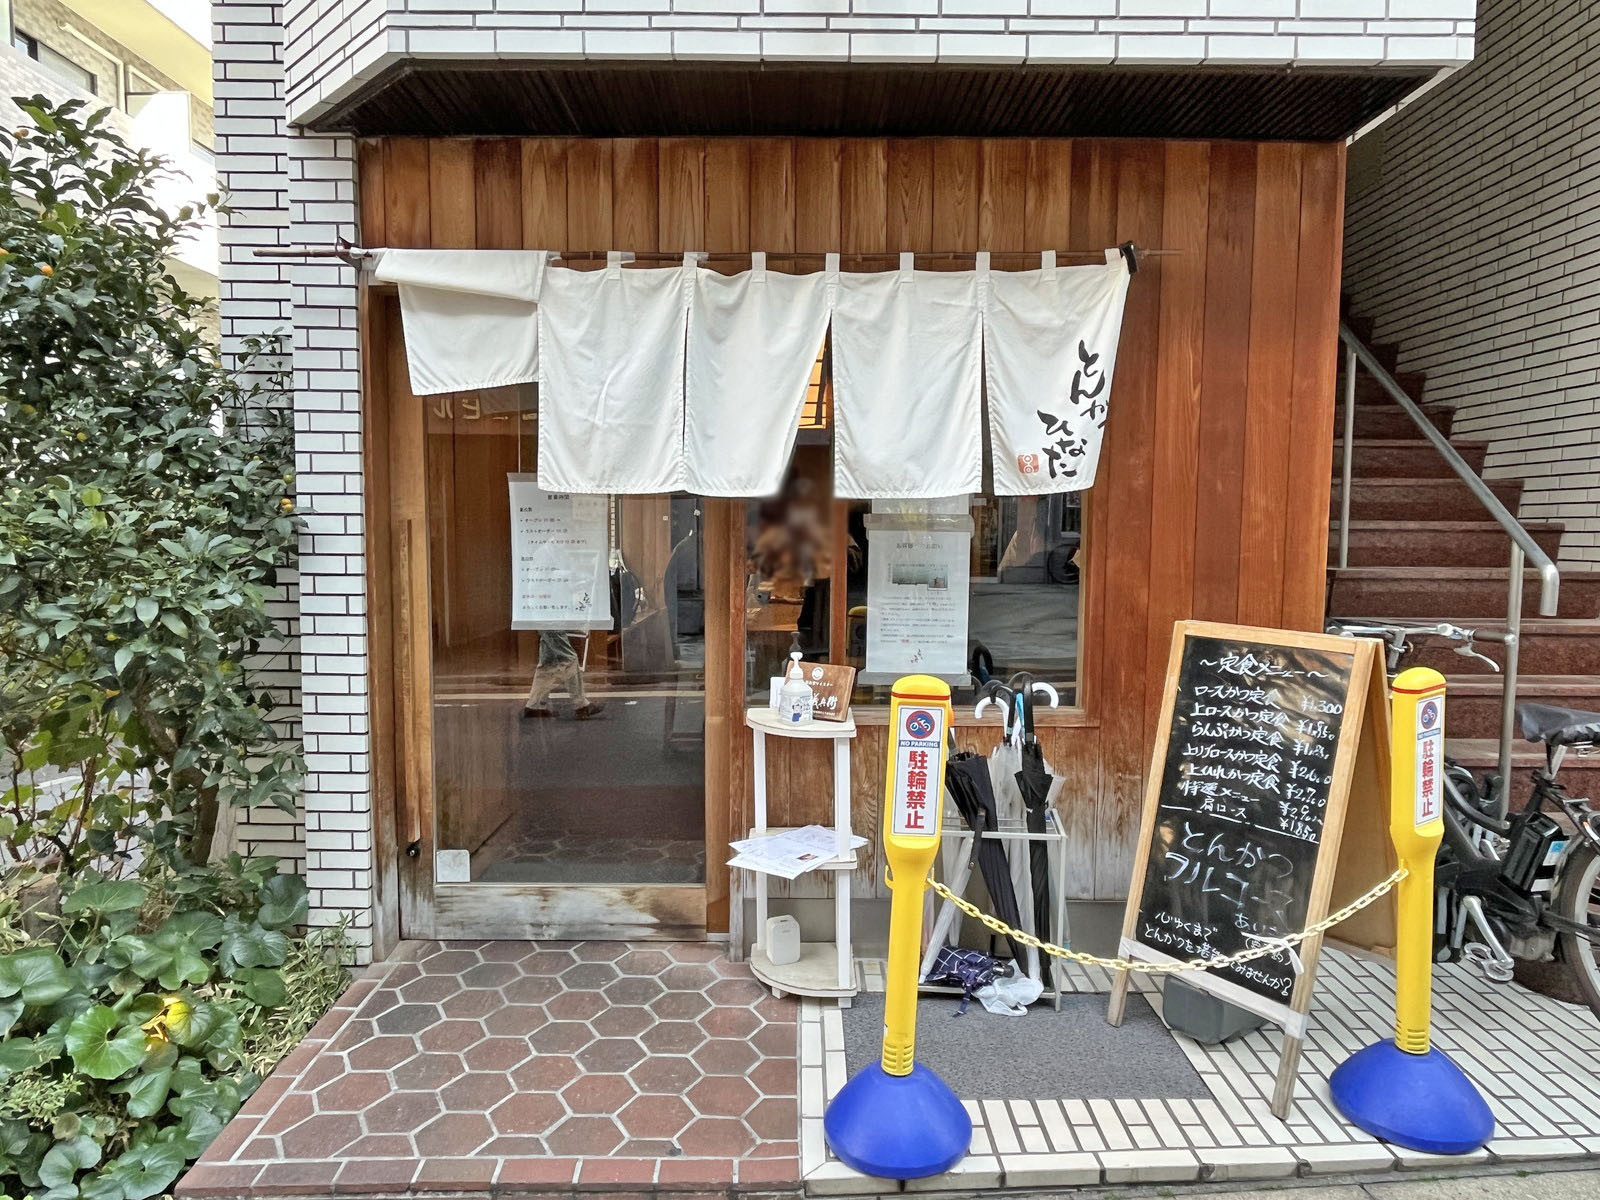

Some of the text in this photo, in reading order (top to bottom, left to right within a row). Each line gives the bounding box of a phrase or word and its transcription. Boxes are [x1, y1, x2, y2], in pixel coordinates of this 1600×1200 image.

[1037, 409, 1088, 479] ひなた
[900, 739, 939, 748] NO PARKING
[905, 751, 928, 829] 駐輪禁止
[1183, 821, 1294, 879] とんかつ
